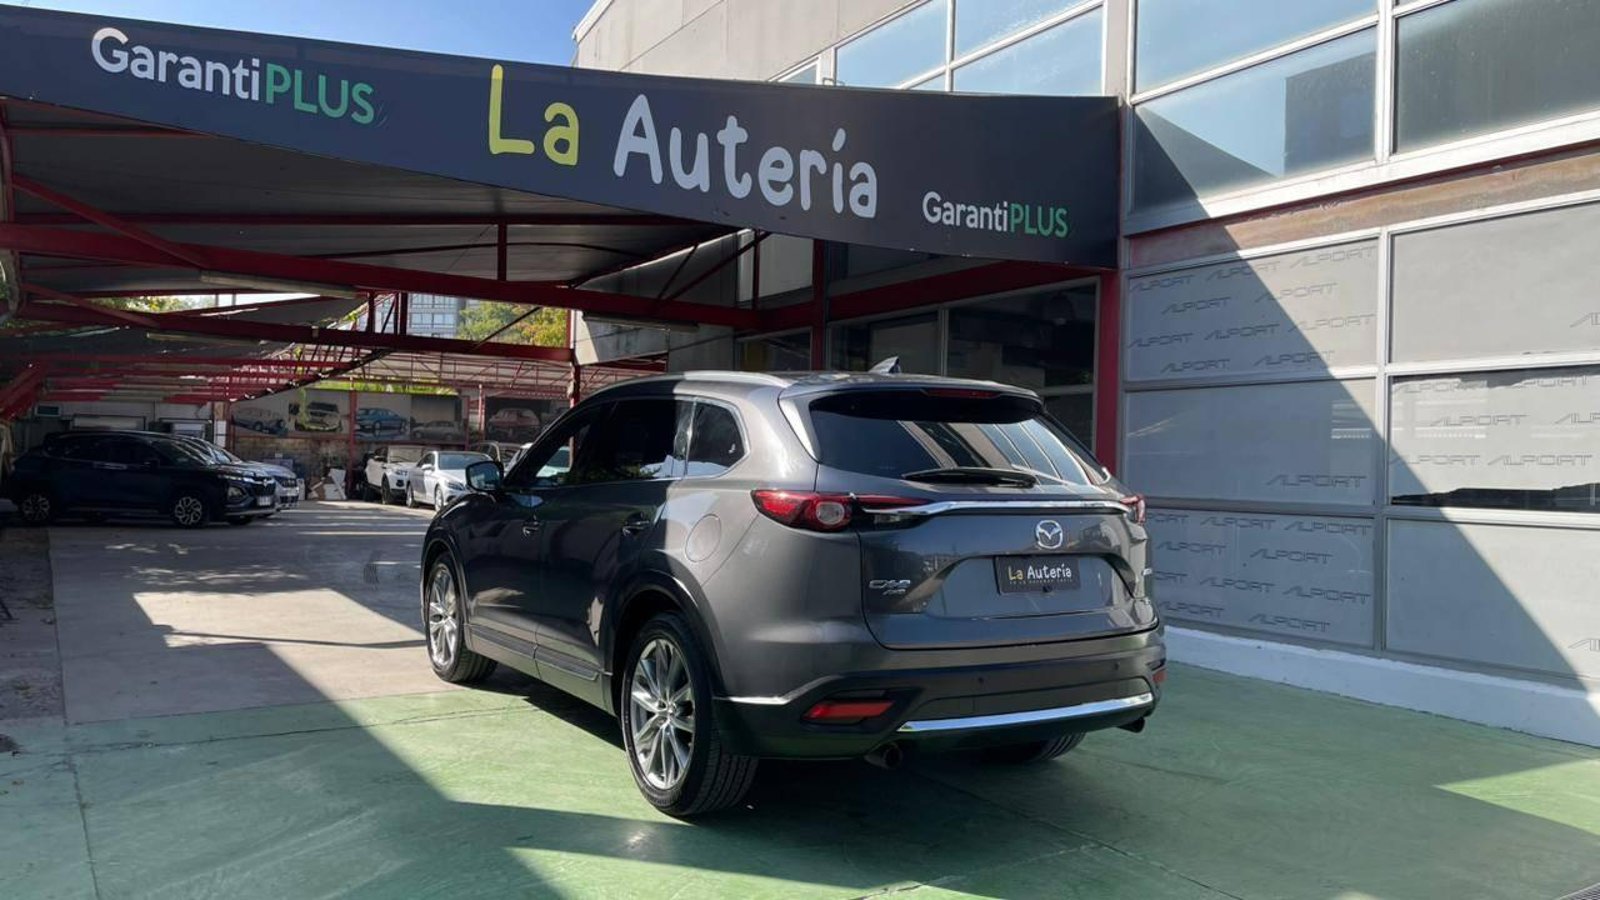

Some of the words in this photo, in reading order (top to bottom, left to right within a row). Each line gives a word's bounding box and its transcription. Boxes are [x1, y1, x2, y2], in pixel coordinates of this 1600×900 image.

[488, 64, 580, 166] La
[613, 93, 878, 219] Autería
[1008, 566, 1024, 581] La
